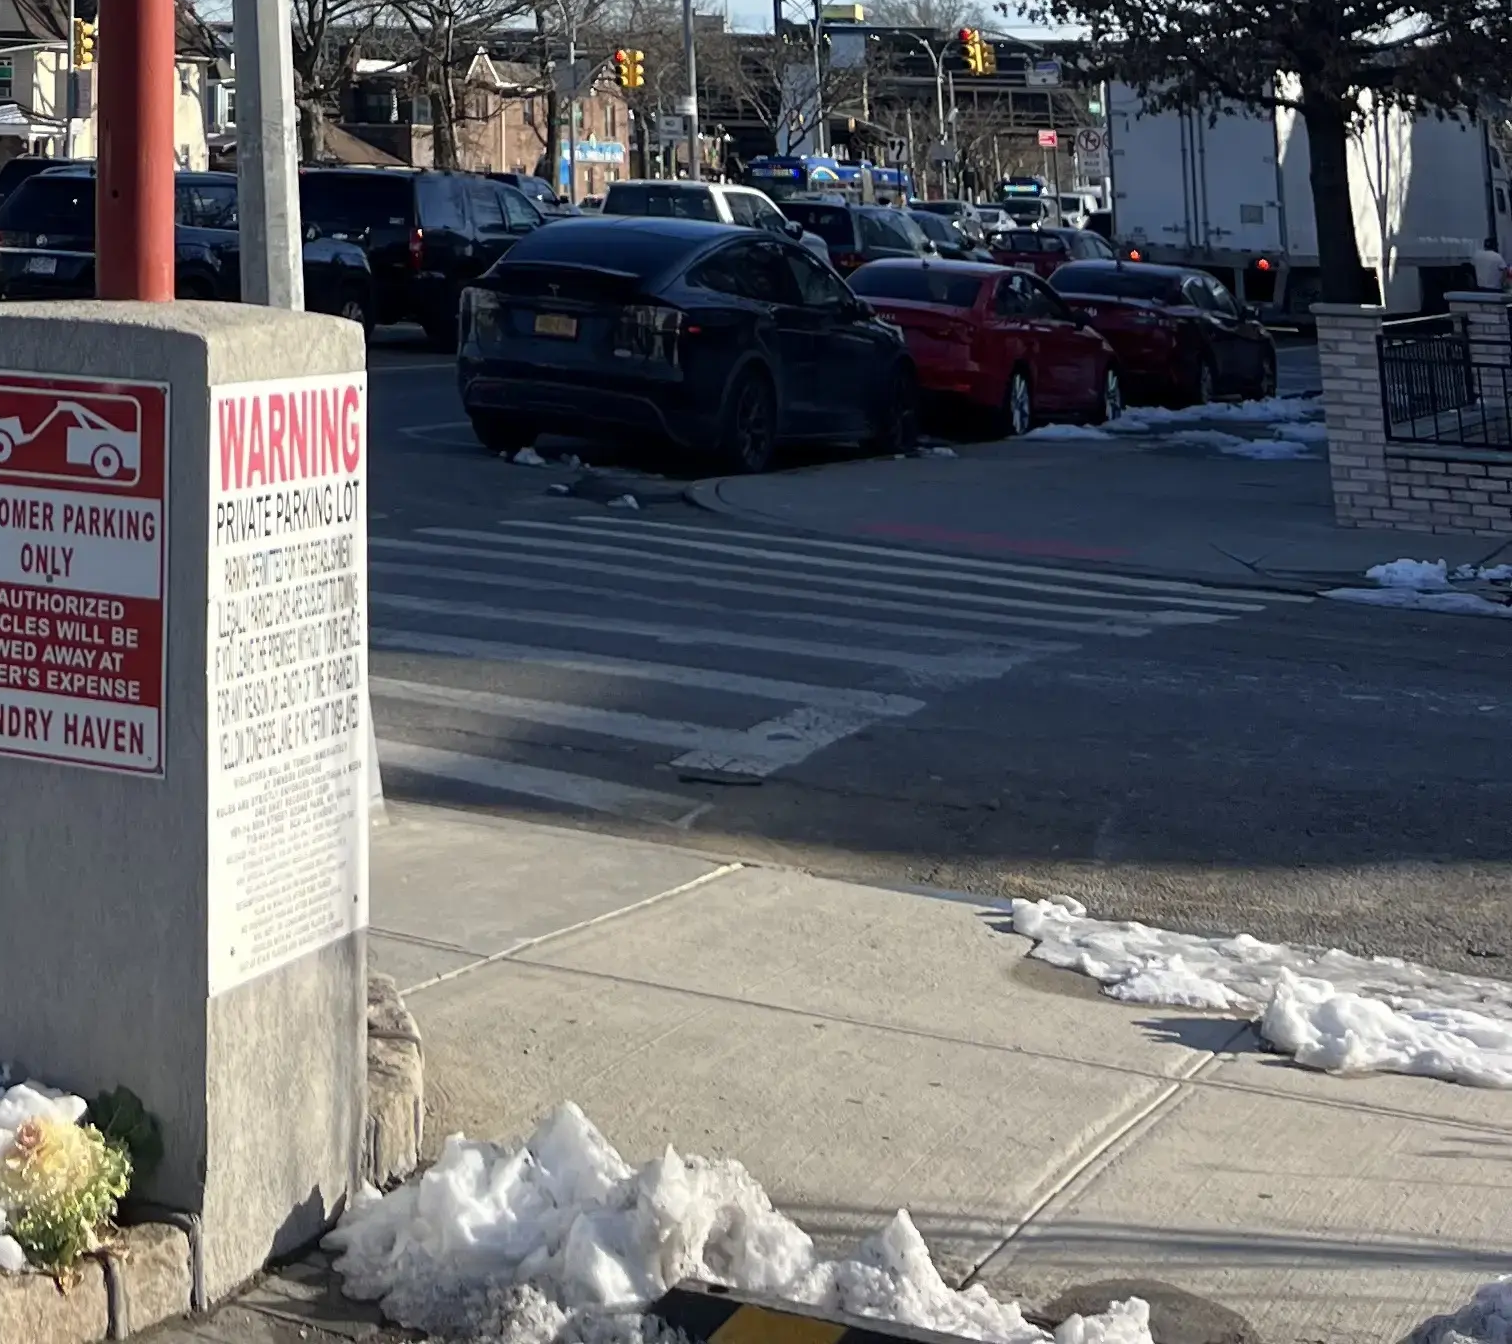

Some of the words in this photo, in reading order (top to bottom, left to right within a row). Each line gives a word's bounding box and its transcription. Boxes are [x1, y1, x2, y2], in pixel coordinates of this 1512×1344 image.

[218, 384, 360, 492] WARNING
[63, 503, 155, 542] PARKING
[217, 494, 272, 546] PRIVATE
[276, 484, 333, 535] PARKING
[337, 480, 360, 523] LOT
[21, 543, 74, 578] ONLY
[56, 619, 104, 645] WILL
[111, 626, 138, 648] BE
[41, 644, 97, 669] AWAY
[98, 651, 124, 672] AT
[46, 670, 141, 700] EXPENSE
[64, 712, 144, 756] HAVEN
